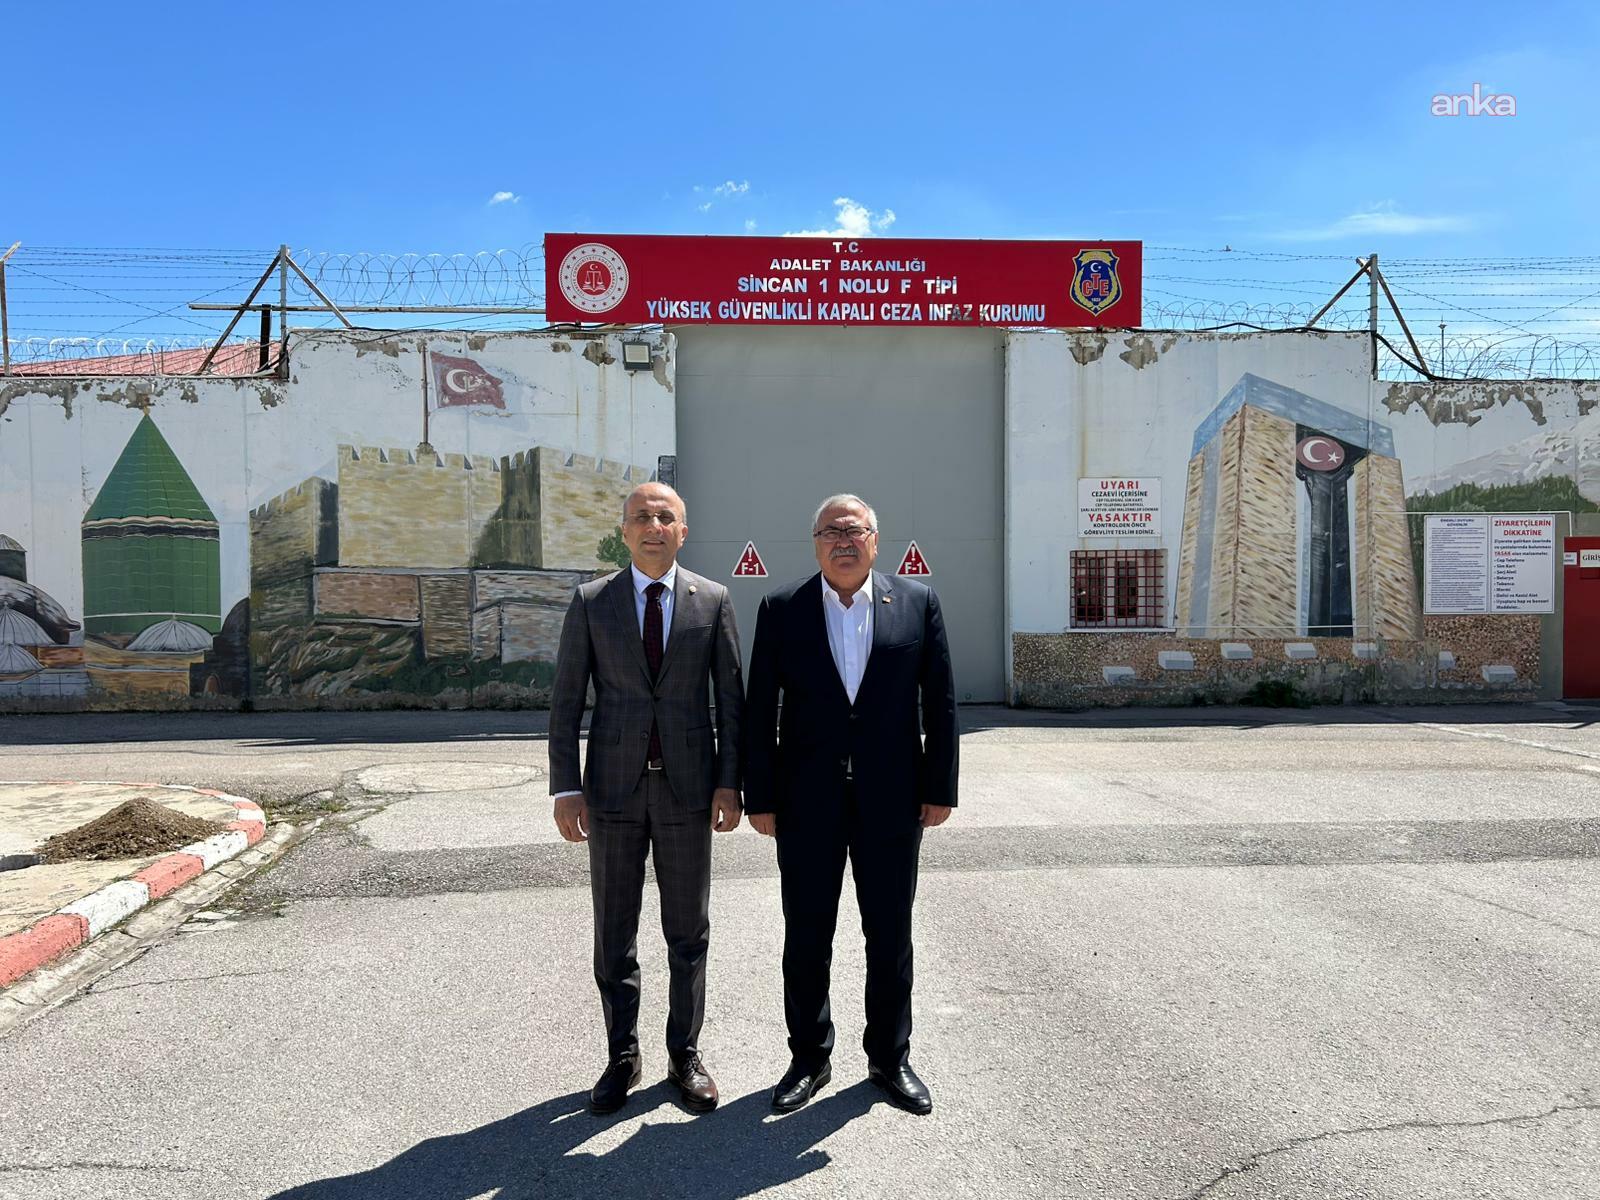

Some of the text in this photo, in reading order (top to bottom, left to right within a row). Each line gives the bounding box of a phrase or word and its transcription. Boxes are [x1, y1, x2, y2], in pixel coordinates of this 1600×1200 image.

[833, 242, 863, 253] T.C.
[770, 258, 926, 272] ADALET BAKANLIĞI
[738, 274, 958, 295] SİNCAN 1 NOLU F TİPİ
[647, 297, 712, 319] YÜKSEK
[719, 298, 812, 320] GÜVENLİKLİ
[818, 302, 874, 320] KAPALI
[881, 303, 922, 321] CEZA
[979, 304, 1046, 322] KURUMU
[1101, 481, 1139, 489] UYARI
[1088, 513, 1152, 522] YASAKTIR
[741, 562, 759, 575] F-1
[905, 562, 923, 574] F-1
